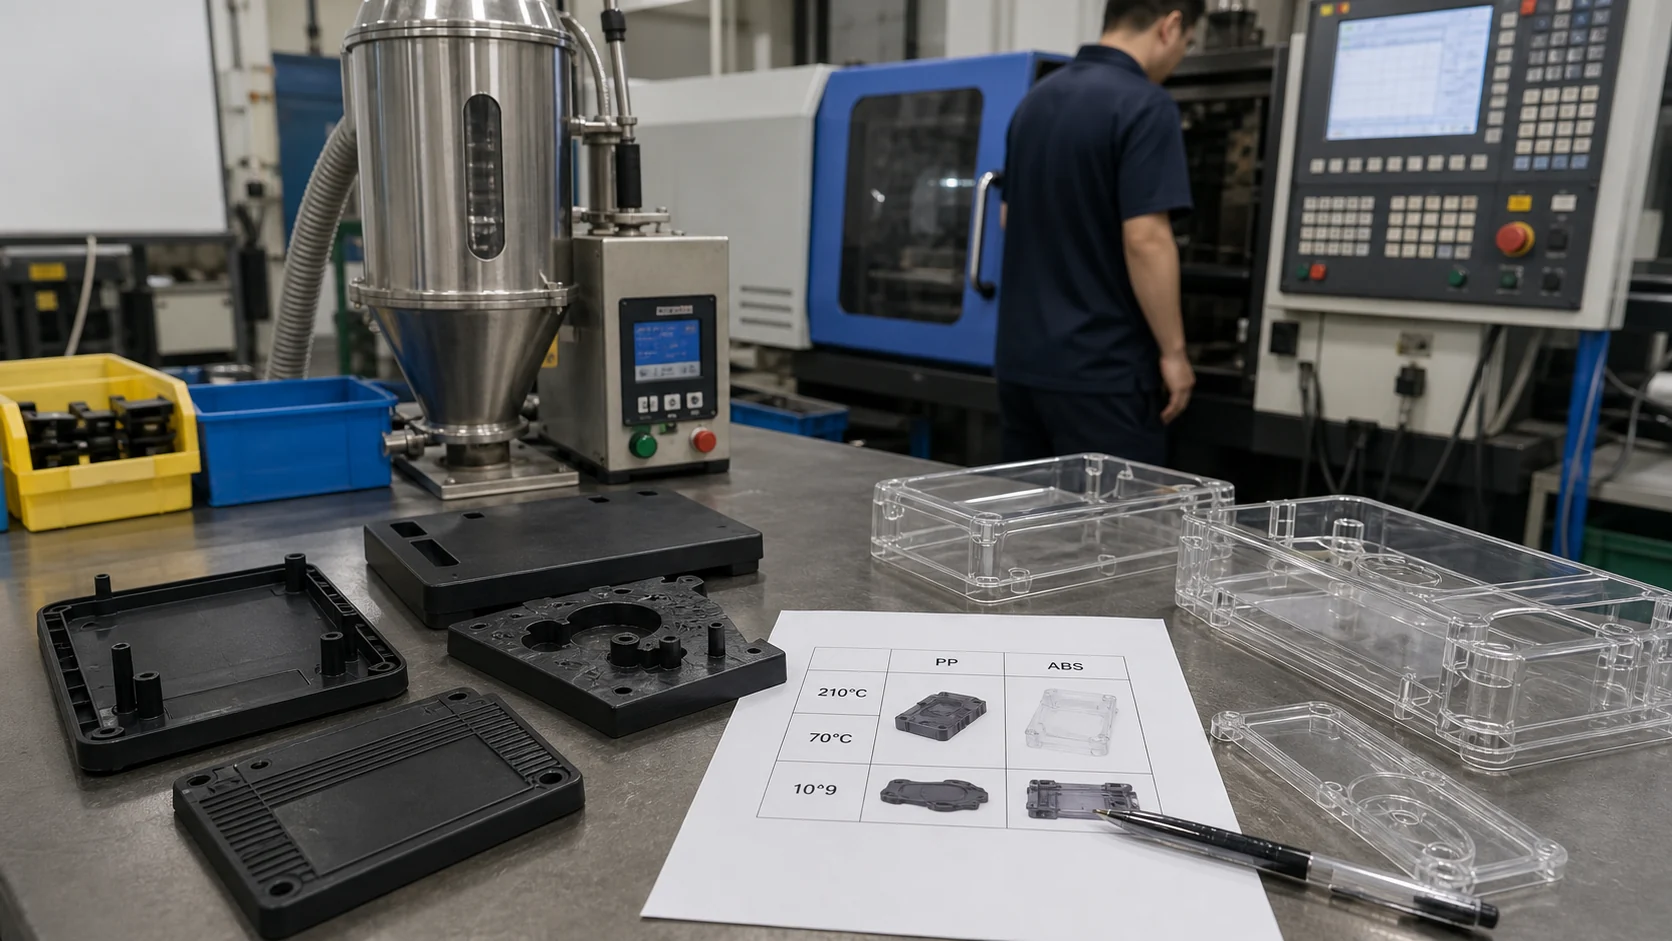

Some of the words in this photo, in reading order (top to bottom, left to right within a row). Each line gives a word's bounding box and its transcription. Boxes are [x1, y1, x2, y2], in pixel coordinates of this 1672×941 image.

[935, 657, 959, 667] PP
[1047, 661, 1085, 671] ABS
[817, 687, 868, 698] 210°C
[809, 732, 854, 744] 70°C
